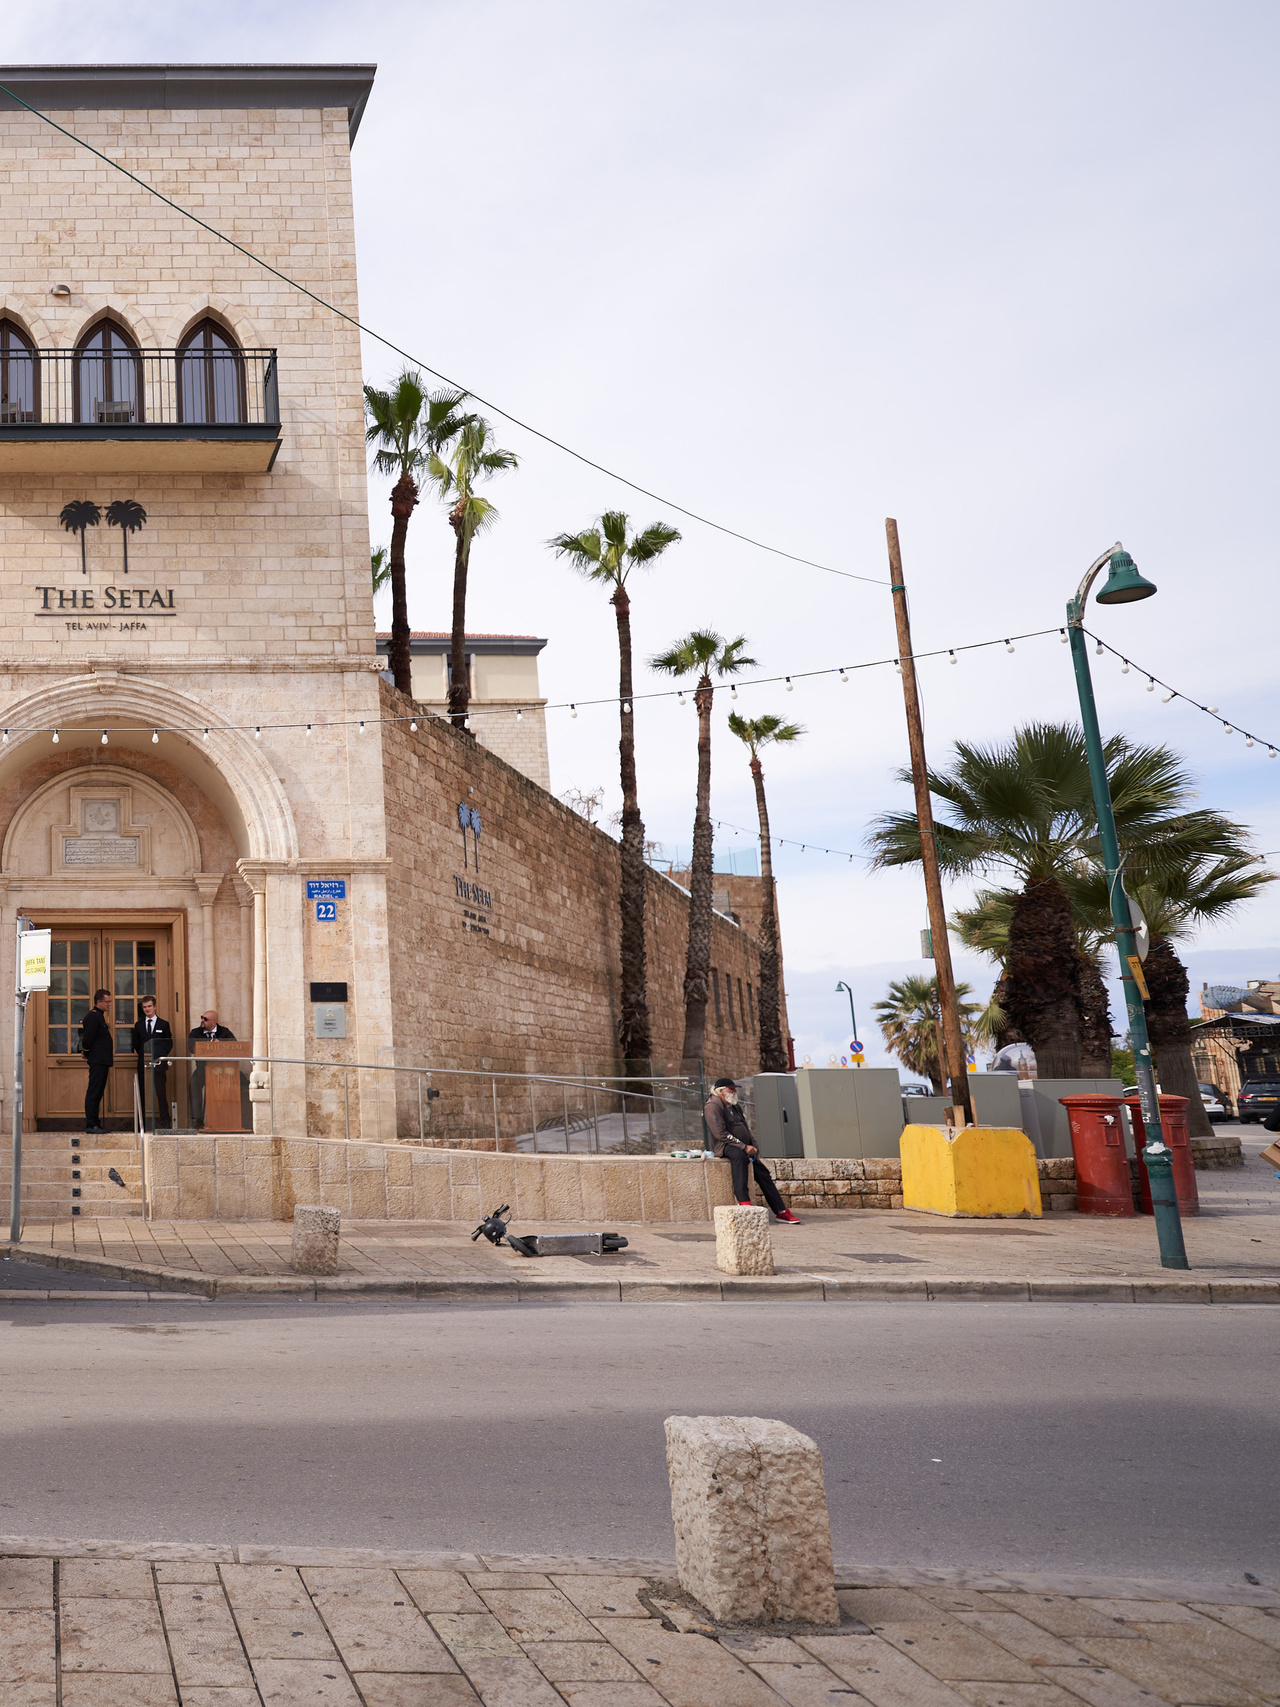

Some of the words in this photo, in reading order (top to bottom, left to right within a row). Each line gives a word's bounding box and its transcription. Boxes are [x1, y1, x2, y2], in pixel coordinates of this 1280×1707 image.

[35, 586, 94, 609] THE
[104, 586, 175, 609] SETAI
[65, 622, 83, 631] TEL
[86, 622, 109, 631] AVIV
[118, 622, 147, 632] JAFFA
[453, 874, 472, 900] THE
[472, 882, 493, 908] SETAI
[318, 904, 335, 918] 22
